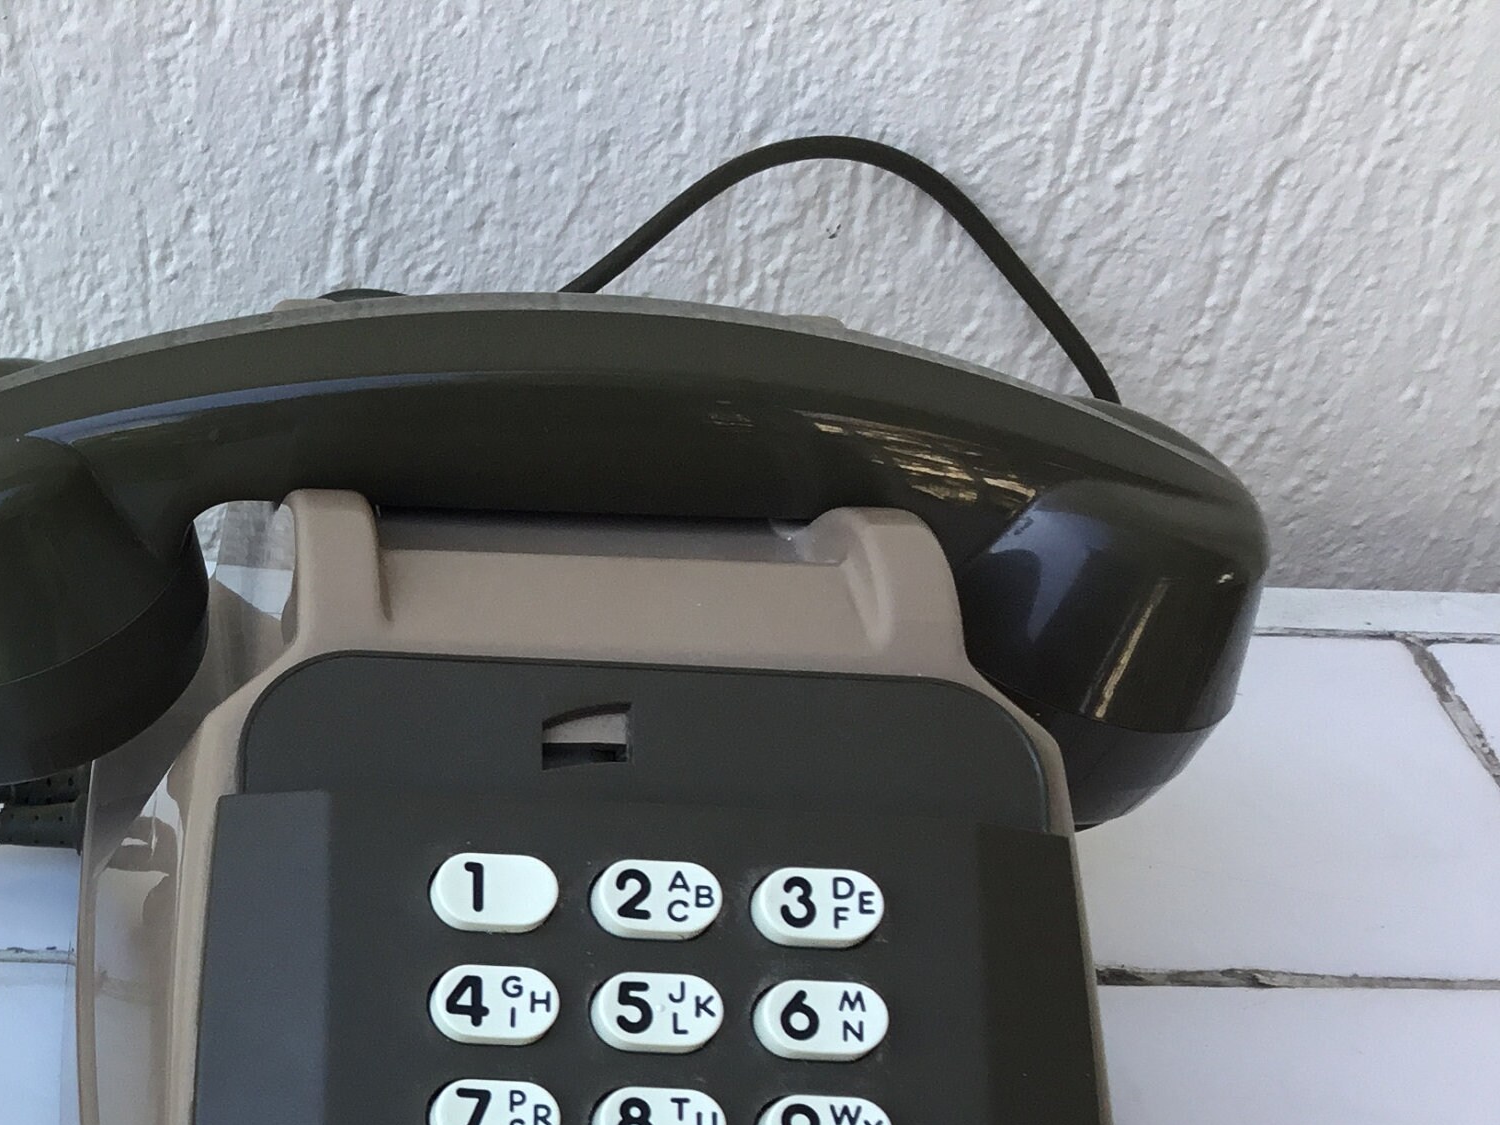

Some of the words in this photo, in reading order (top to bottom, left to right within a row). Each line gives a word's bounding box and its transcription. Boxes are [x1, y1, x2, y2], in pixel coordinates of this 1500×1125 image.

[462, 860, 486, 914] 1
[614, 867, 653, 922] 2
[778, 874, 818, 930] 3
[444, 973, 491, 1029] 4
[615, 979, 655, 1036] 5
[778, 988, 821, 1042] 6
